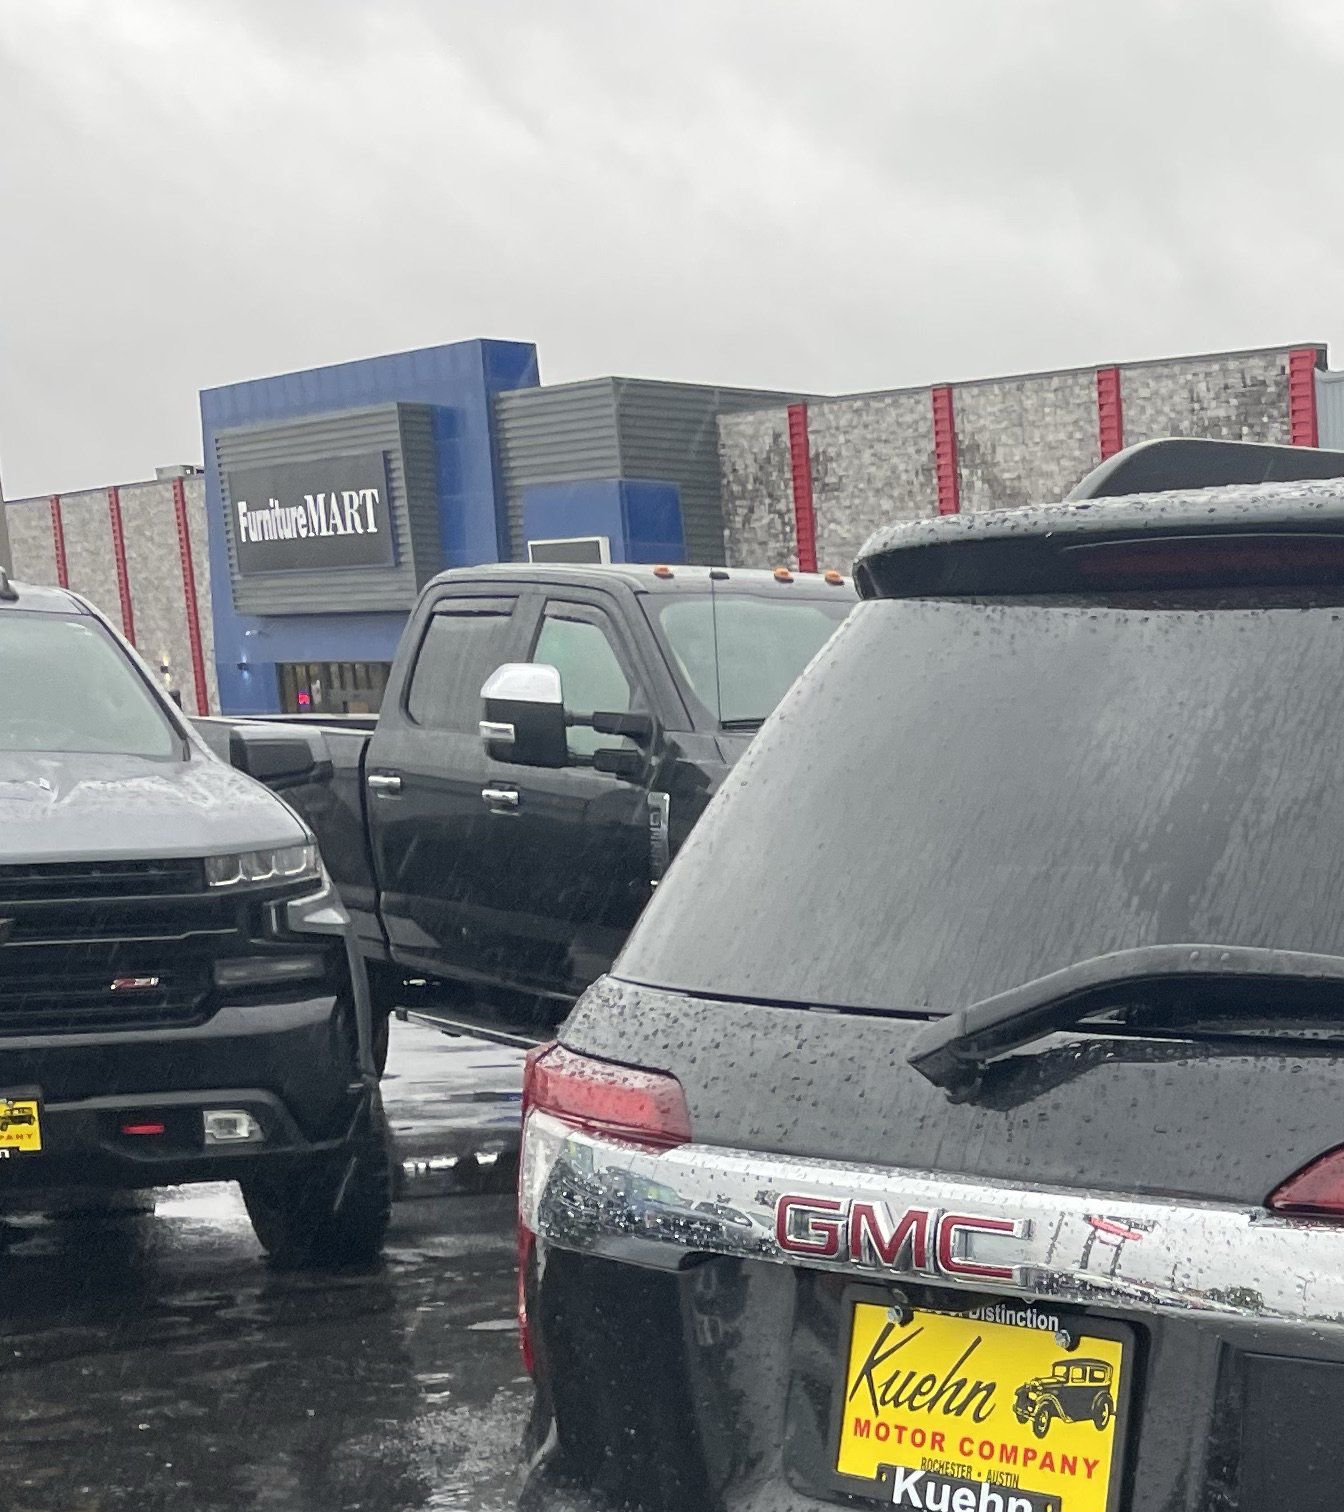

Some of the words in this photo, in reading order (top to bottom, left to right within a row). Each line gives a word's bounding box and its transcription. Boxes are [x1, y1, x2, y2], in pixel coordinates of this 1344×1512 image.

[774, 1191, 1025, 1284] GMC
[849, 1322, 997, 1424] Kuehn
[853, 1417, 946, 1452] MOTOR
[958, 1437, 1101, 1480] COMPANY
[920, 1456, 973, 1479] ROCHESTER
